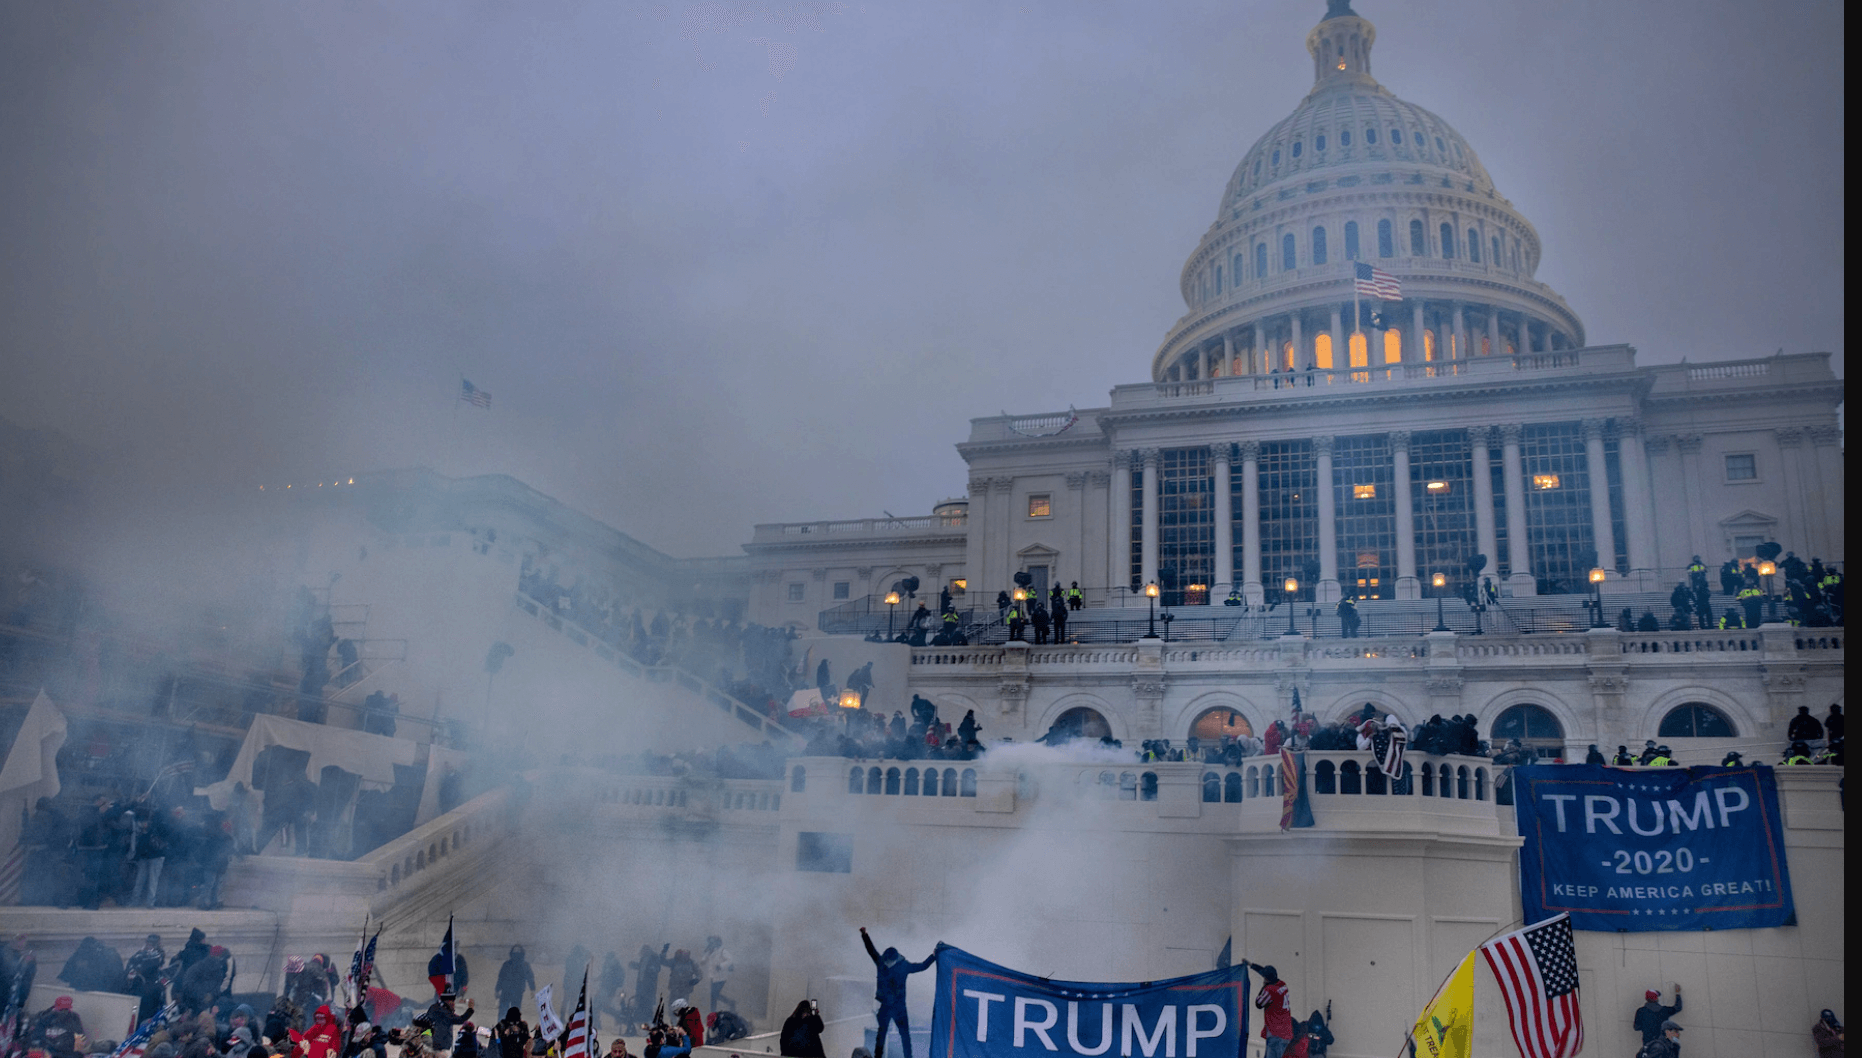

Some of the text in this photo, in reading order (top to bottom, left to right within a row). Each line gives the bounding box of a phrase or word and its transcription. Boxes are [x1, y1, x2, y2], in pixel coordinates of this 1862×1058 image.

[1542, 786, 1750, 837] TRUMP
[1553, 879, 1772, 899] KEEP AMERICA GREAT!
[963, 989, 1227, 1057] TRUMP
